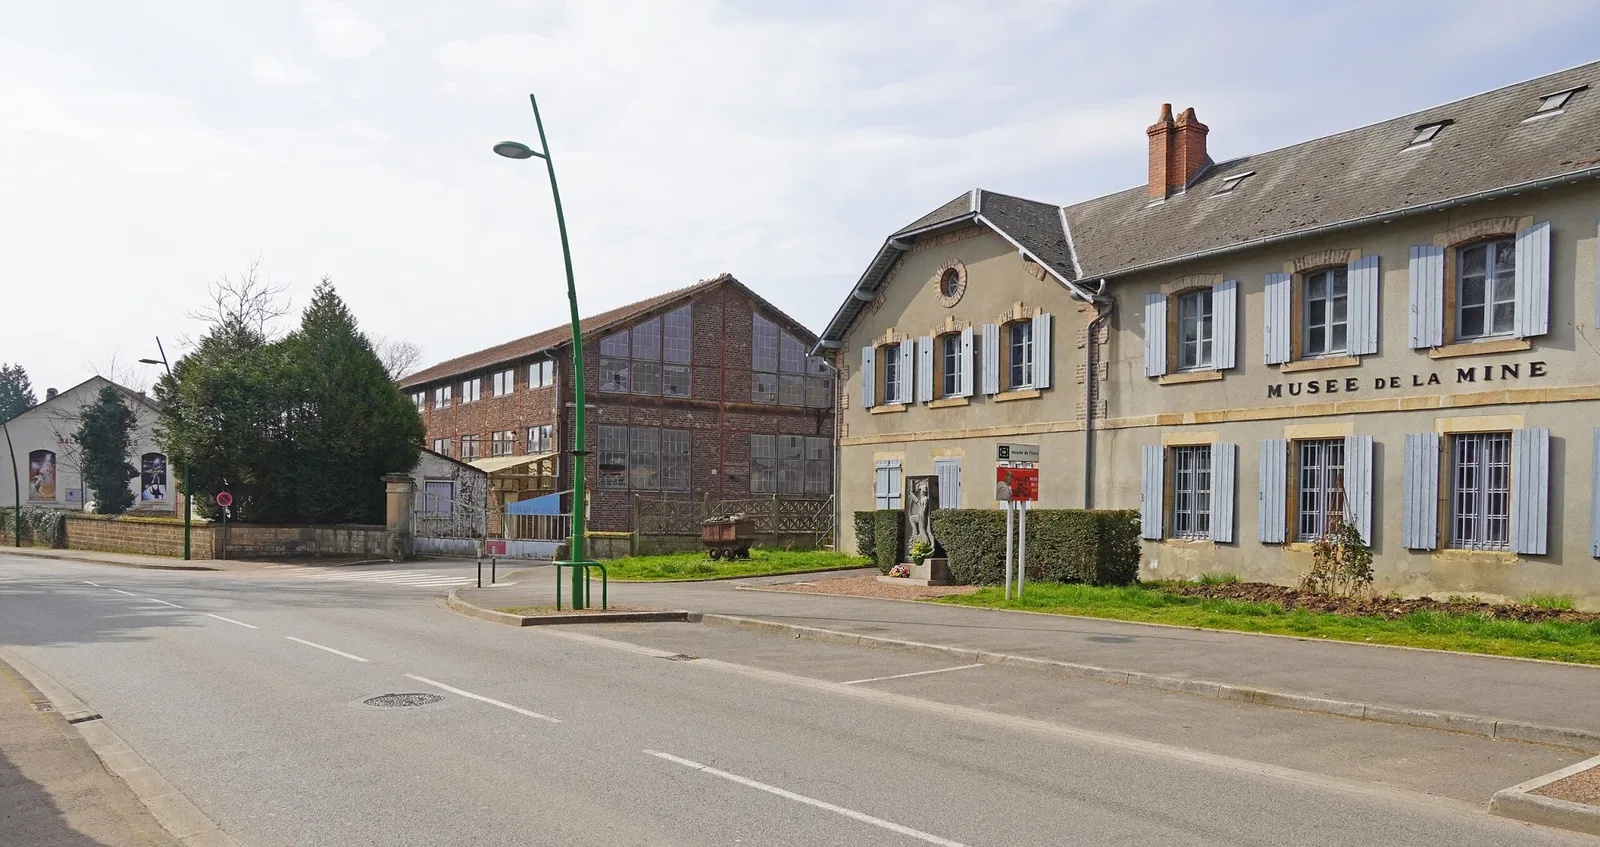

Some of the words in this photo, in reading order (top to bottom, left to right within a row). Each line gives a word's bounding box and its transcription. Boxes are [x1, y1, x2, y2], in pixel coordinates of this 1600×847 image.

[1267, 377, 1361, 399] MUSEE
[1374, 376, 1402, 390] DE
[1412, 372, 1441, 387] LA
[1456, 360, 1549, 384] MINE
